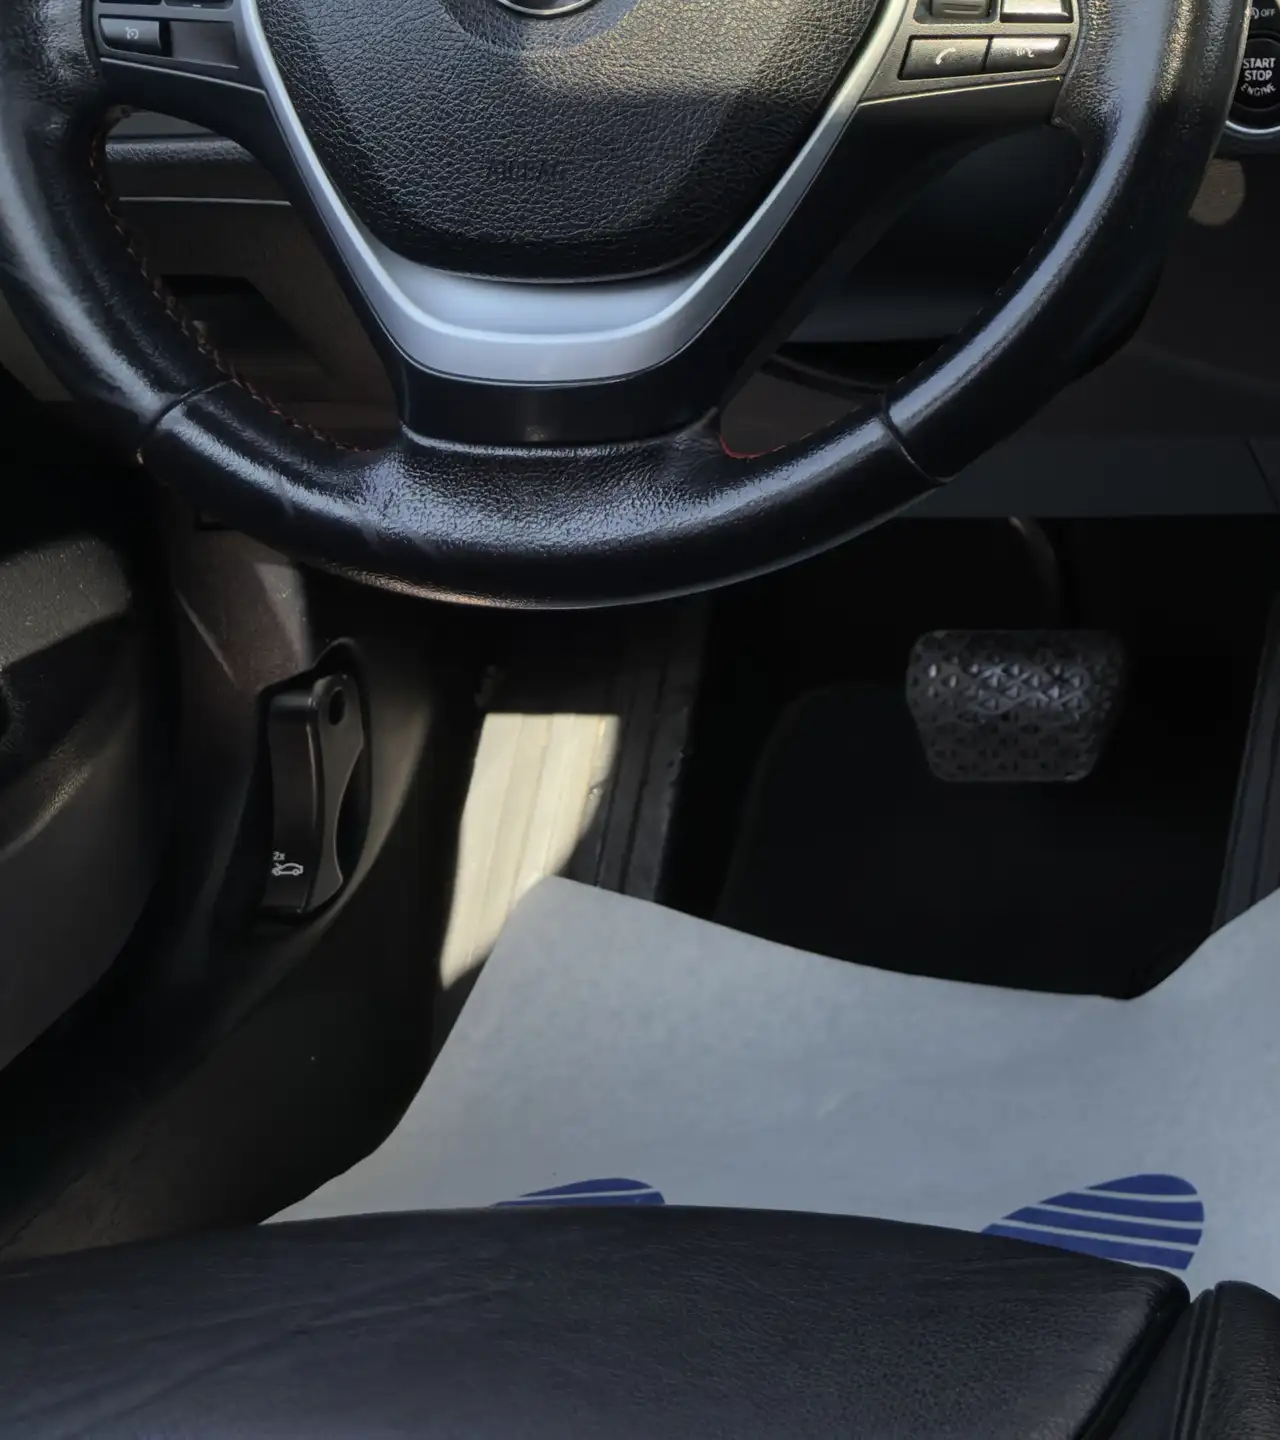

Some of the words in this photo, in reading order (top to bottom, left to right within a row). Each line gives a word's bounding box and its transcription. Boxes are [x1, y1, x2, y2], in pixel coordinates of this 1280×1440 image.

[1261, 8, 1276, 17] OFF
[1242, 57, 1276, 69] START
[1244, 70, 1273, 82] STOP
[1240, 82, 1277, 97] ENGINE
